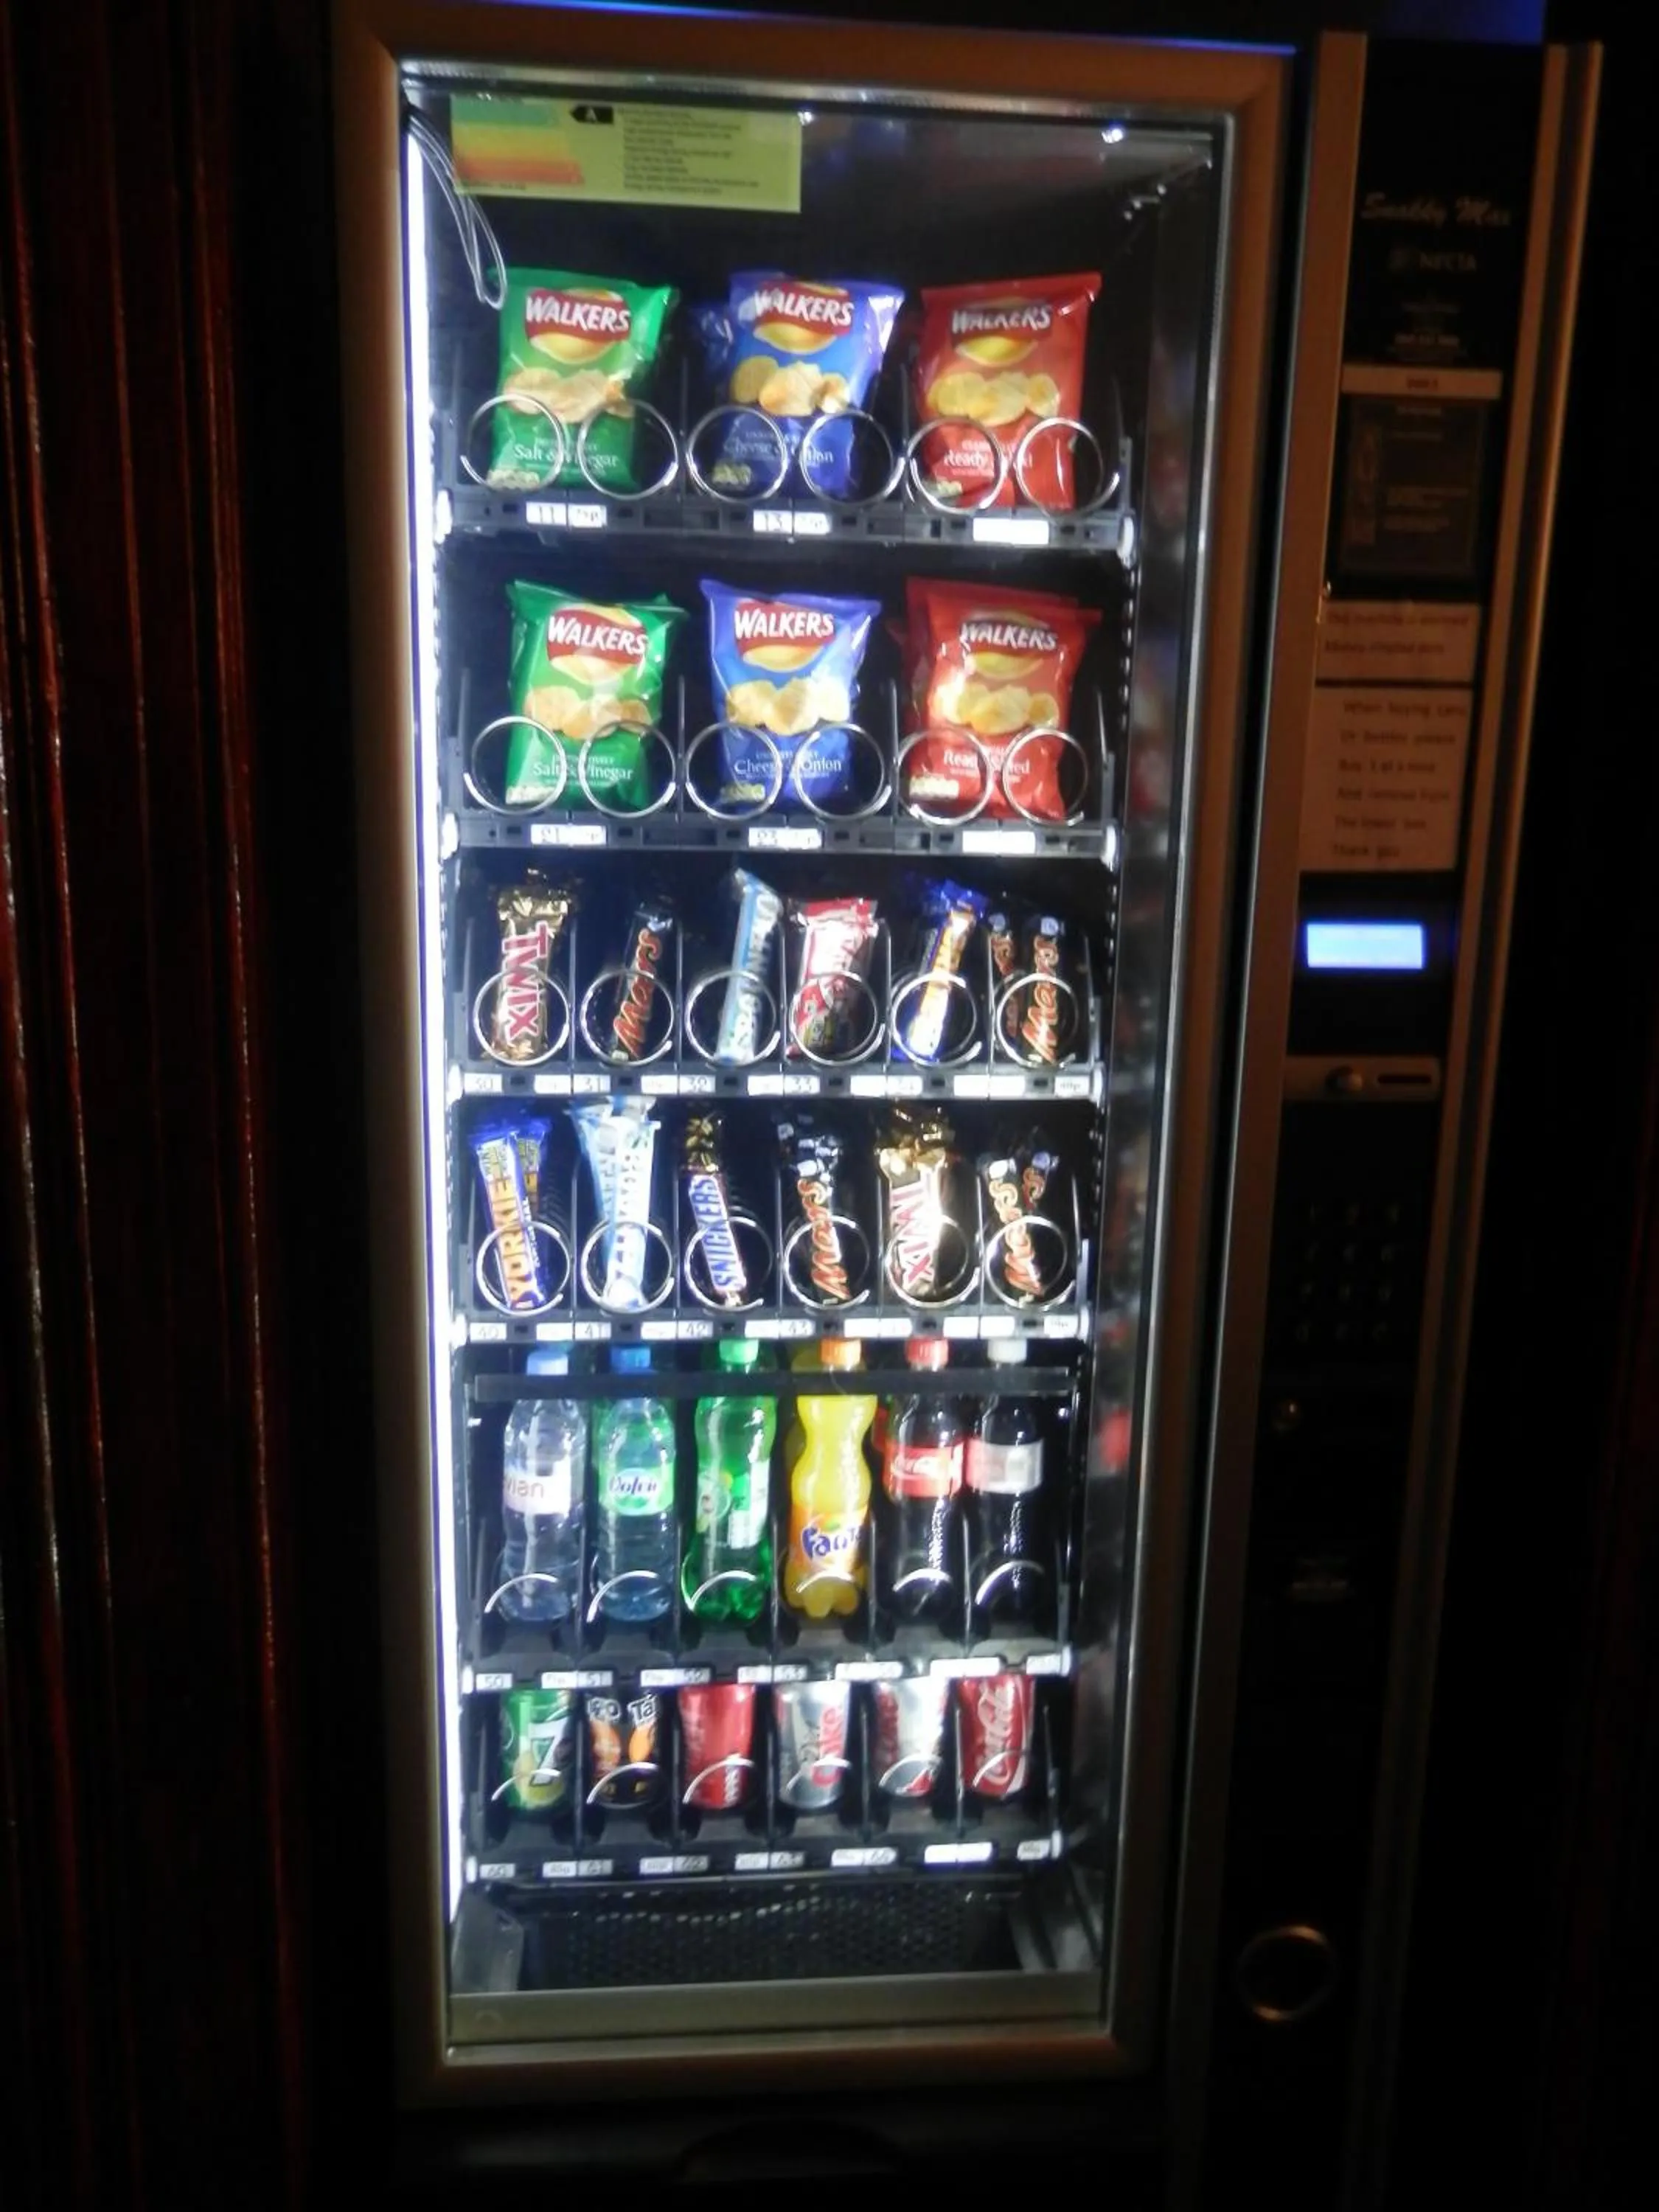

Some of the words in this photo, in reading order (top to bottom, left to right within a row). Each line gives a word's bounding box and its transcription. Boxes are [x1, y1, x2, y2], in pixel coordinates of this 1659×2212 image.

[525, 294, 632, 333] WALKERS
[753, 288, 855, 327] WALKERS
[547, 616, 647, 655] WALKERS
[734, 610, 835, 639] WALKERS
[960, 622, 1059, 650] WALKERS
[502, 919, 550, 1047] TWIX
[689, 1175, 736, 1289] SNICKERS
